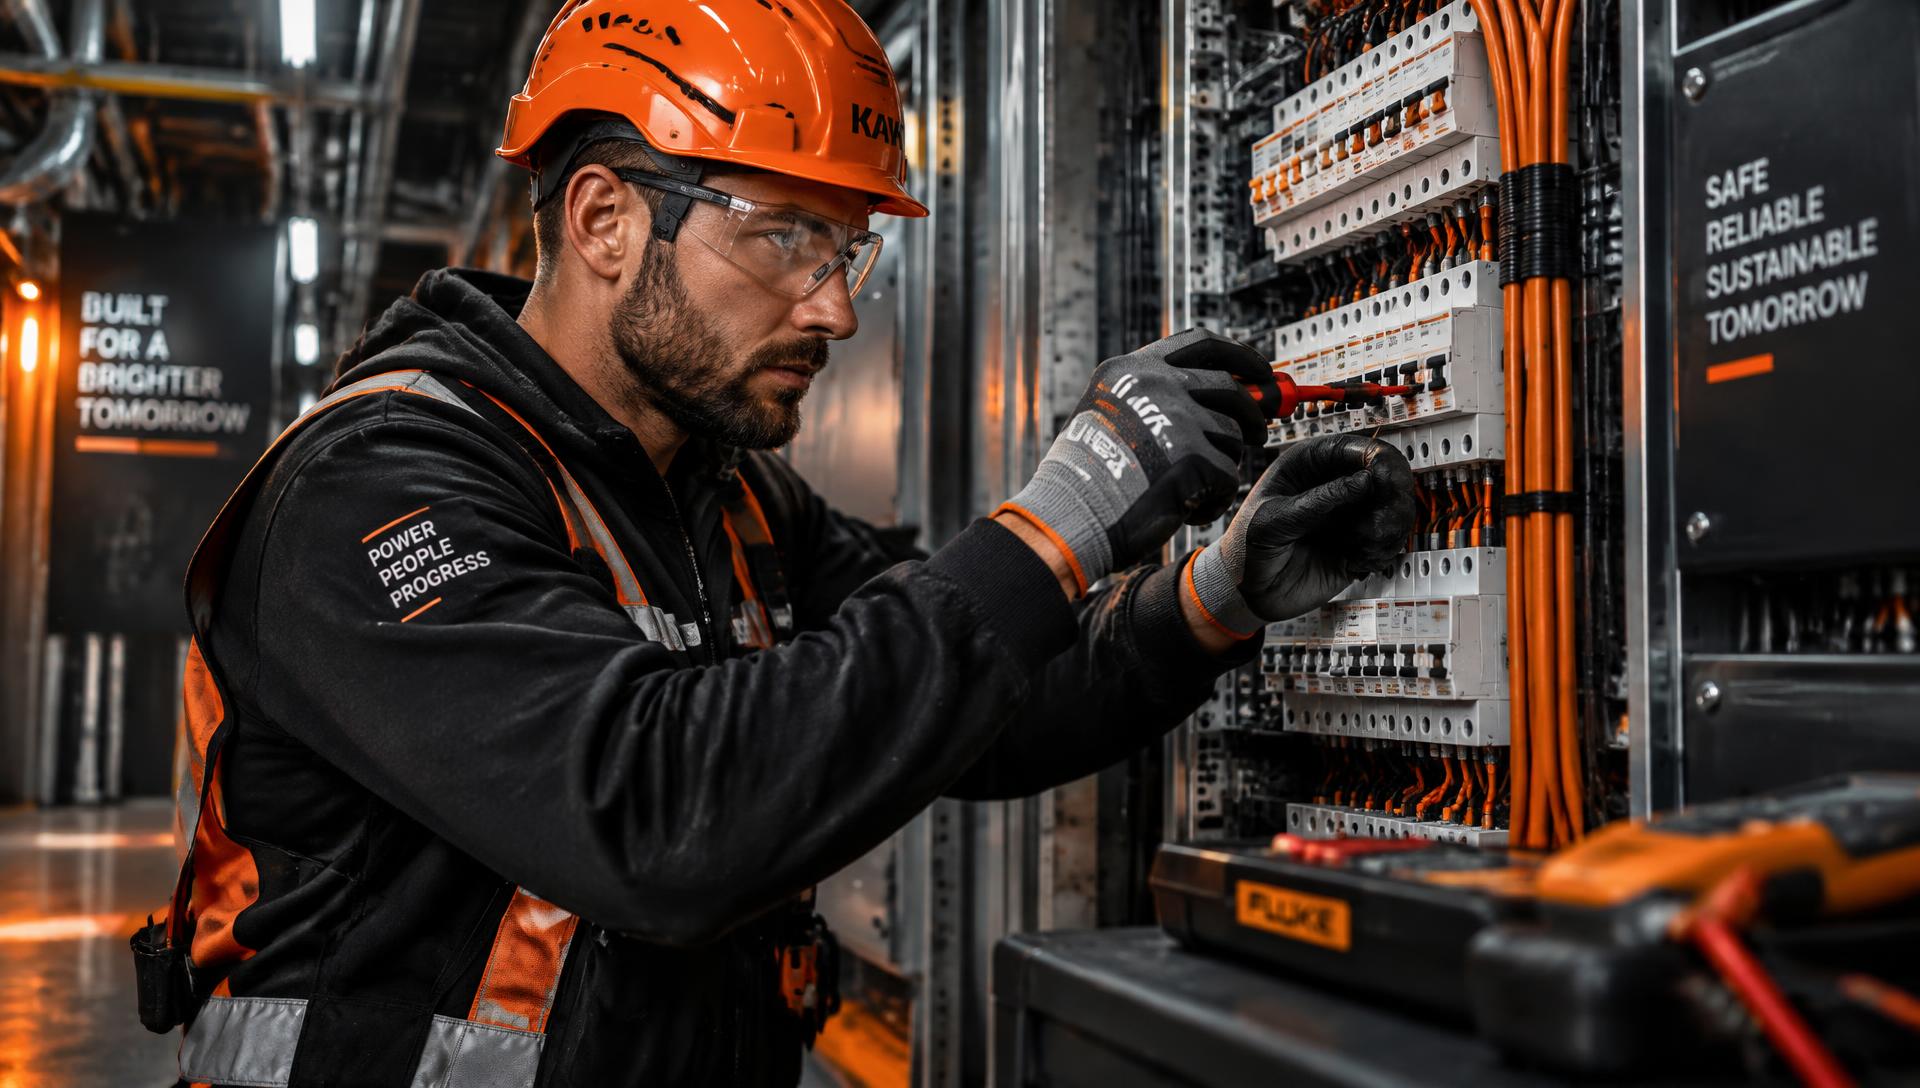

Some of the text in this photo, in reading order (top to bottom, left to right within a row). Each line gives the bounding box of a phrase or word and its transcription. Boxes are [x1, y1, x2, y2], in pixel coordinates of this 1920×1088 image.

[1705, 157, 1770, 209] SAFE
[1705, 186, 1825, 255] RELIABLE
[1705, 218, 1879, 299] SUSTAINABLE
[81, 291, 169, 326] BUILT
[1705, 271, 1869, 345] TOMORROW
[79, 327, 170, 361] FOR A
[77, 361, 223, 399] BRIGHTER
[75, 396, 251, 434] TOMORROW
[368, 520, 437, 568] POWER
[378, 537, 455, 588] PEOPLE
[389, 550, 491, 609] PROGRESS
